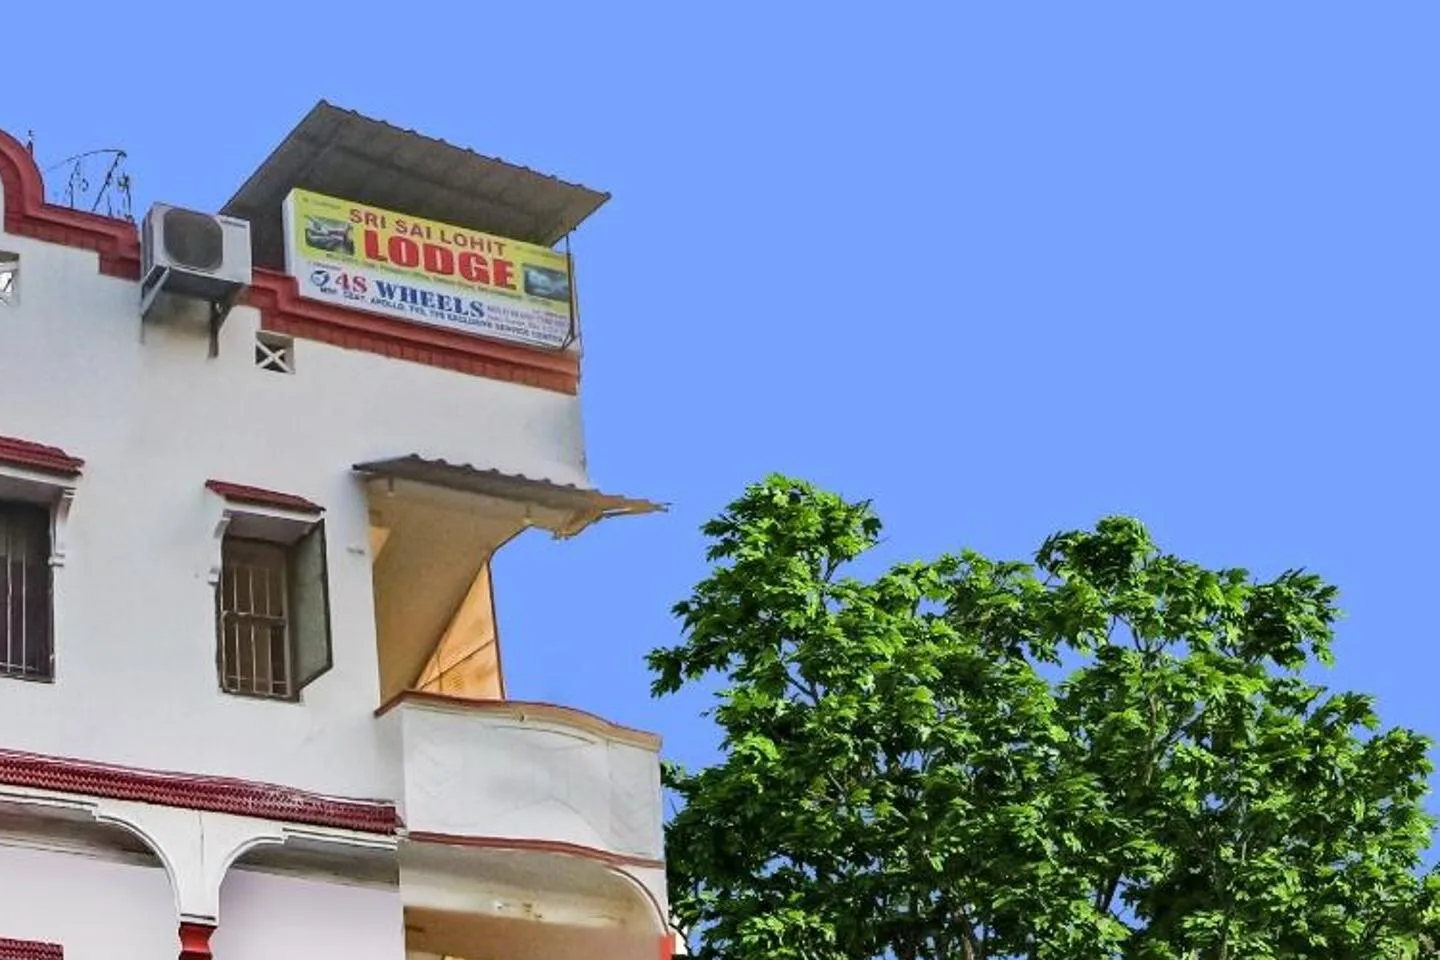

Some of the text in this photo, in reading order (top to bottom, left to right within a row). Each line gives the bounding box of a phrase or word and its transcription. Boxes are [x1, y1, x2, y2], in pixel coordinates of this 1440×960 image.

[349, 208, 508, 257] SRI SAI LOHIT
[364, 229, 517, 290] LODGE
[335, 272, 368, 294] 4S
[375, 280, 485, 318] WHEELS
